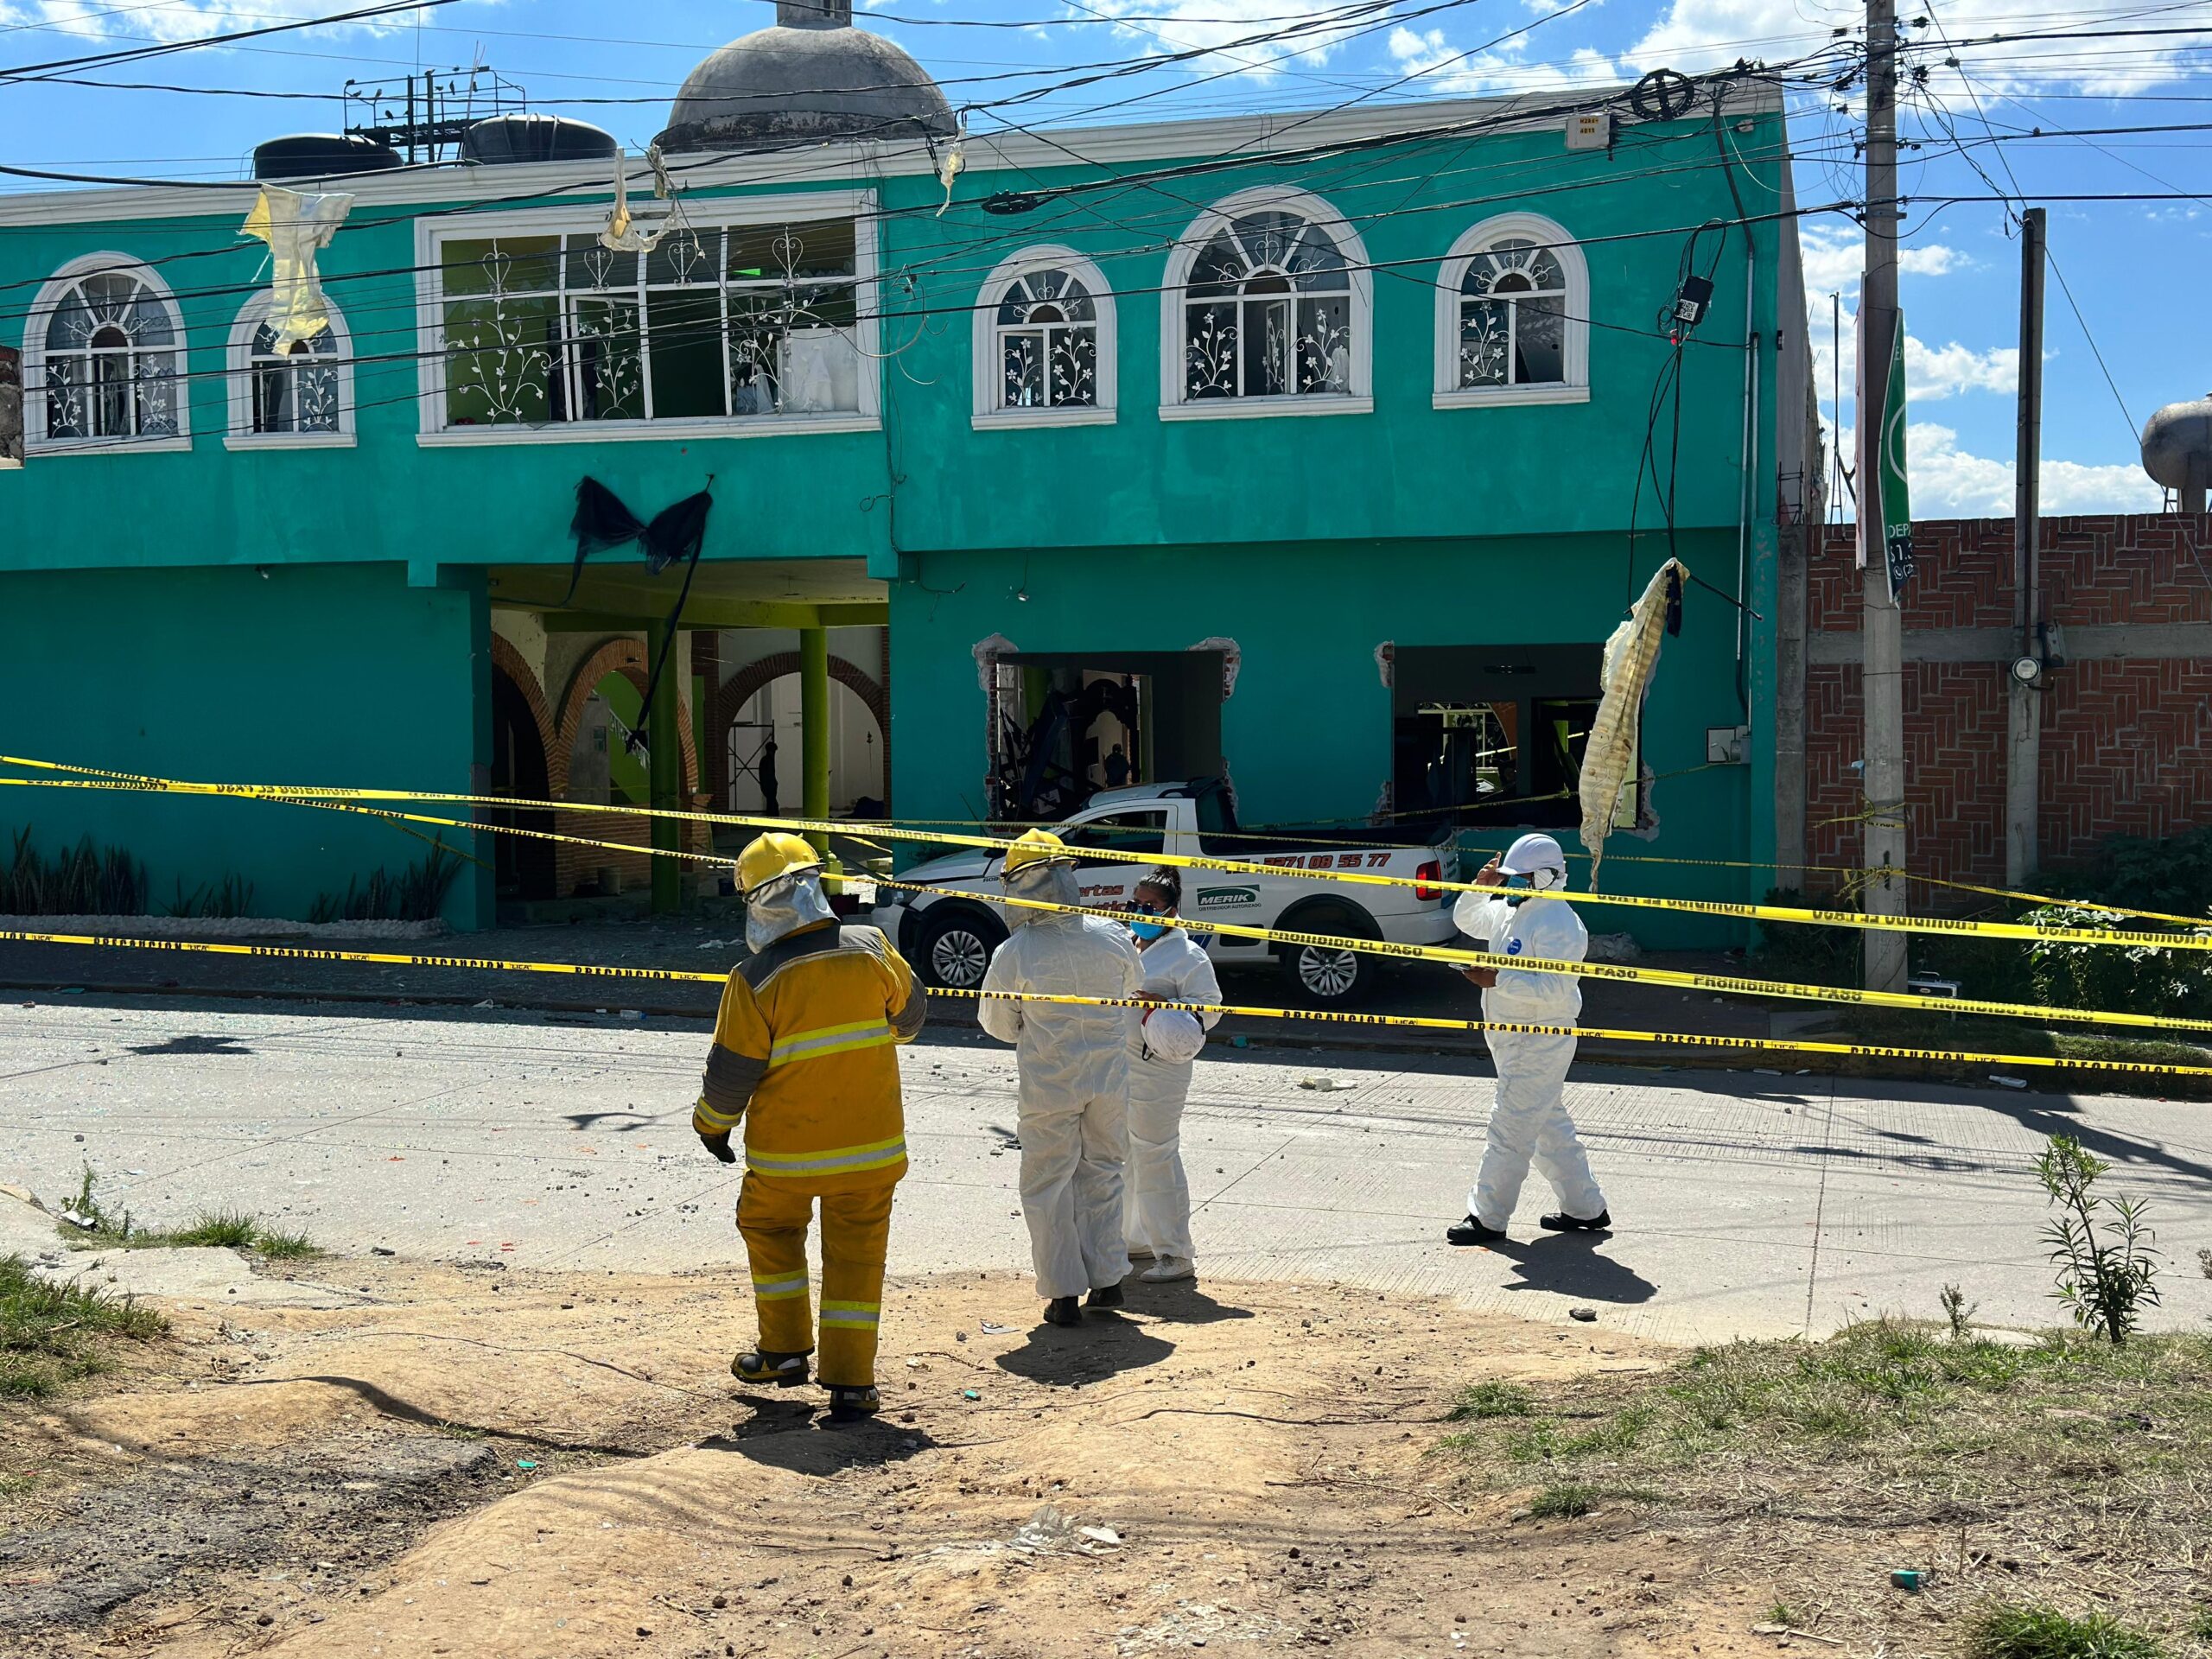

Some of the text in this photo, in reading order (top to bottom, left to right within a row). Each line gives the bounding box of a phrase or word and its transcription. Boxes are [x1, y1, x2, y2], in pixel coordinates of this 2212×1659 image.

[1308, 855, 1333, 869] 08
[1337, 854, 1363, 868] 55
[1366, 852, 1392, 867] 77
[1200, 893, 1250, 905] MERIK
[1268, 931, 1423, 957] PROHIBIDO EL PASO
[1476, 954, 1638, 979] PROHIBIDO EL PASO
